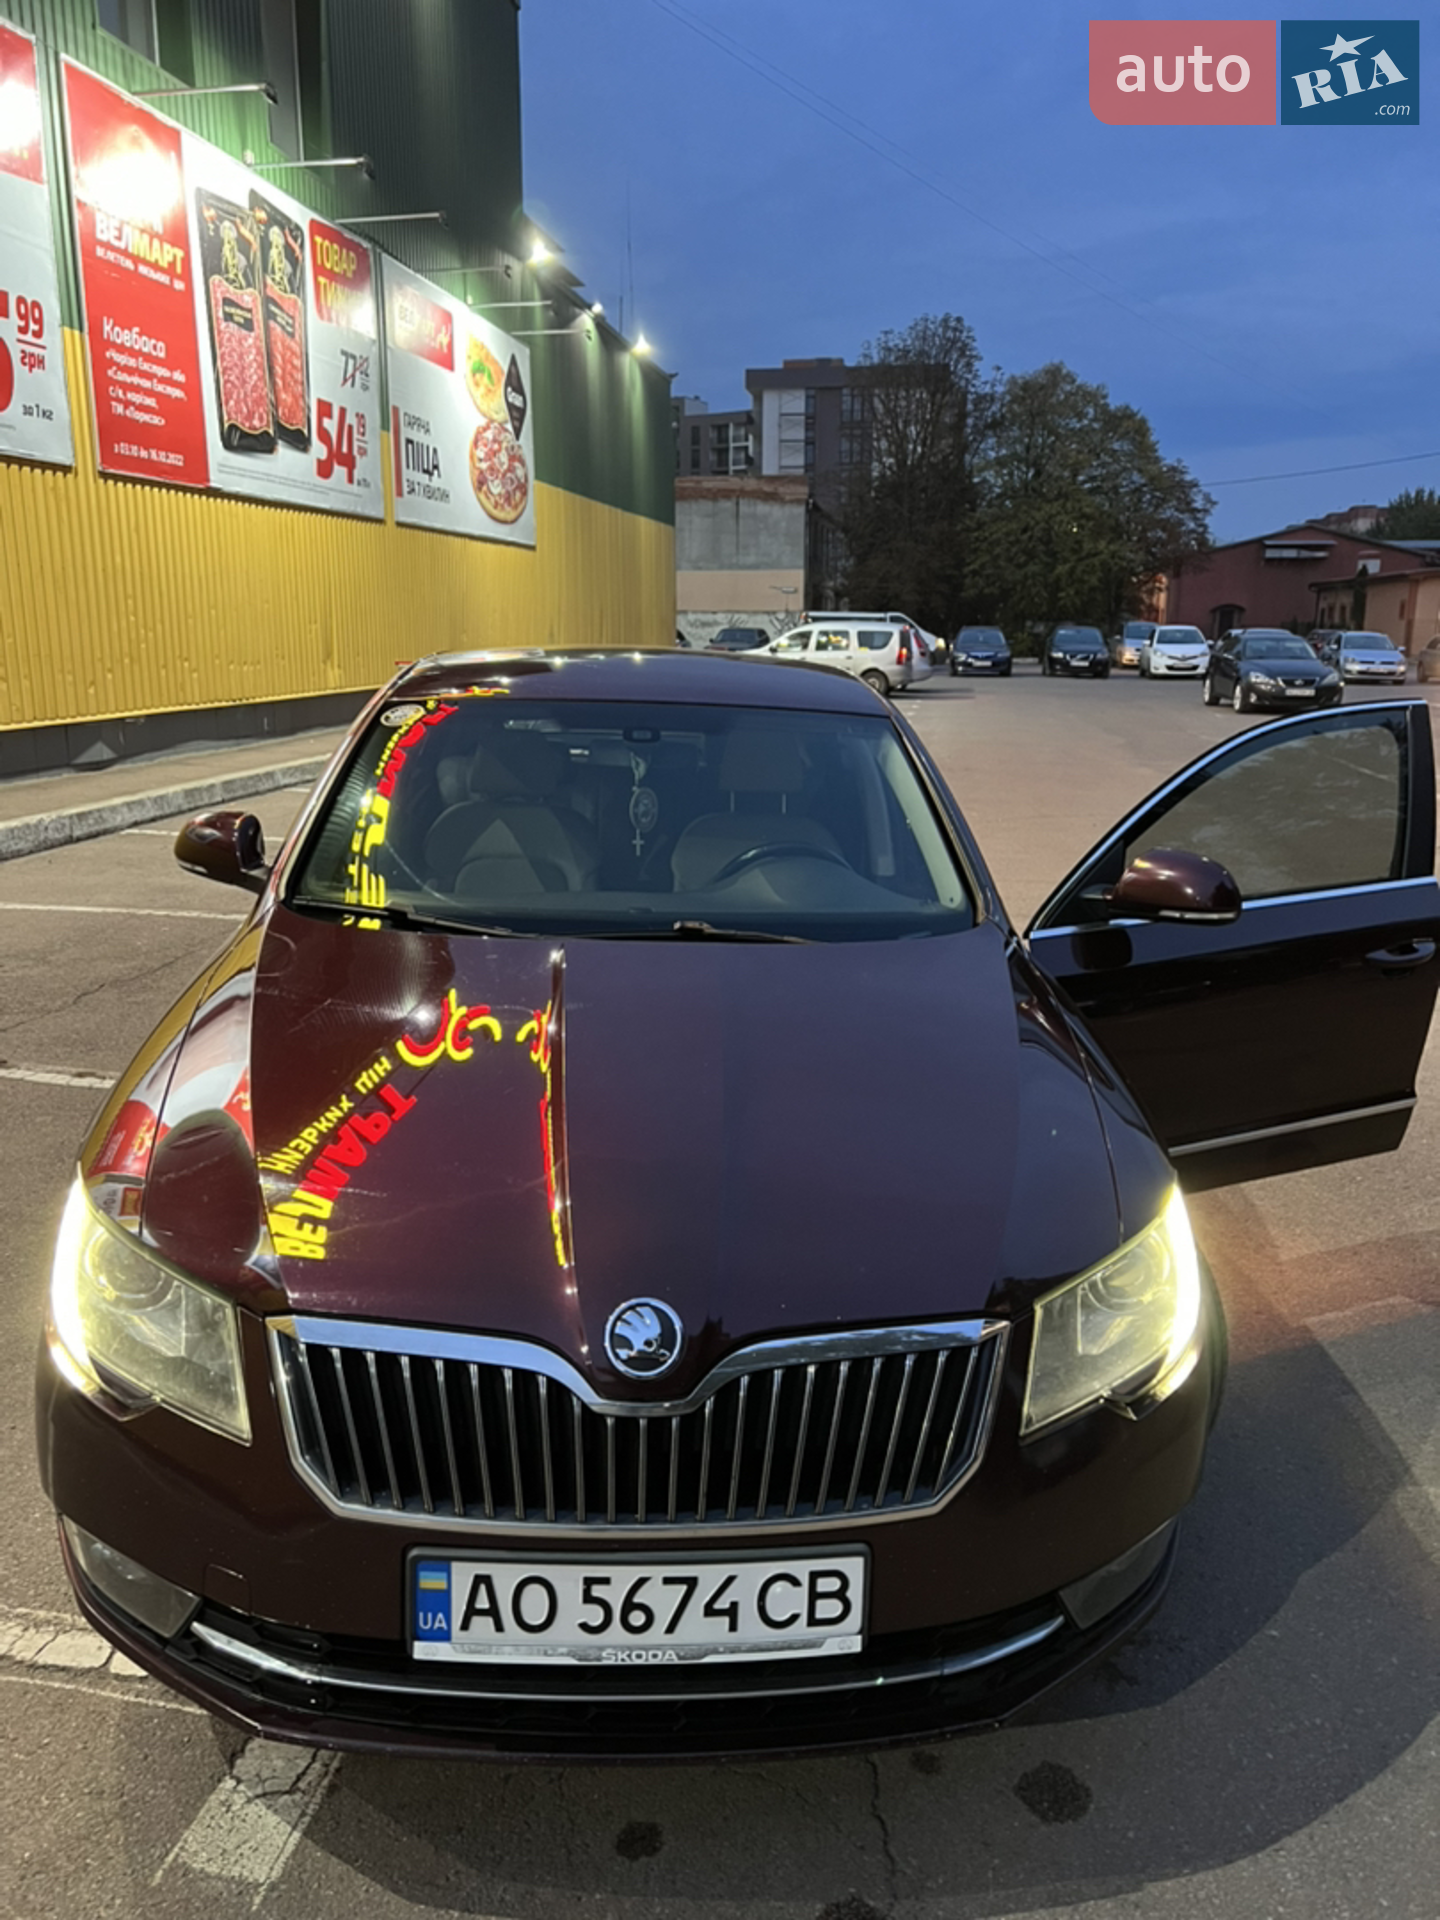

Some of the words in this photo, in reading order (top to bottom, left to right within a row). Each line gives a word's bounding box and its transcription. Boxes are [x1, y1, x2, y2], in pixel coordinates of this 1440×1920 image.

[313, 235, 357, 278] ТОВАР
[15, 295, 43, 339] 99
[102, 316, 166, 358] Ковбаса
[316, 398, 356, 485] 54
[405, 437, 442, 482] ПІЦА
[418, 1612, 448, 1631] UA
[576, 1575, 739, 1636] 5674
